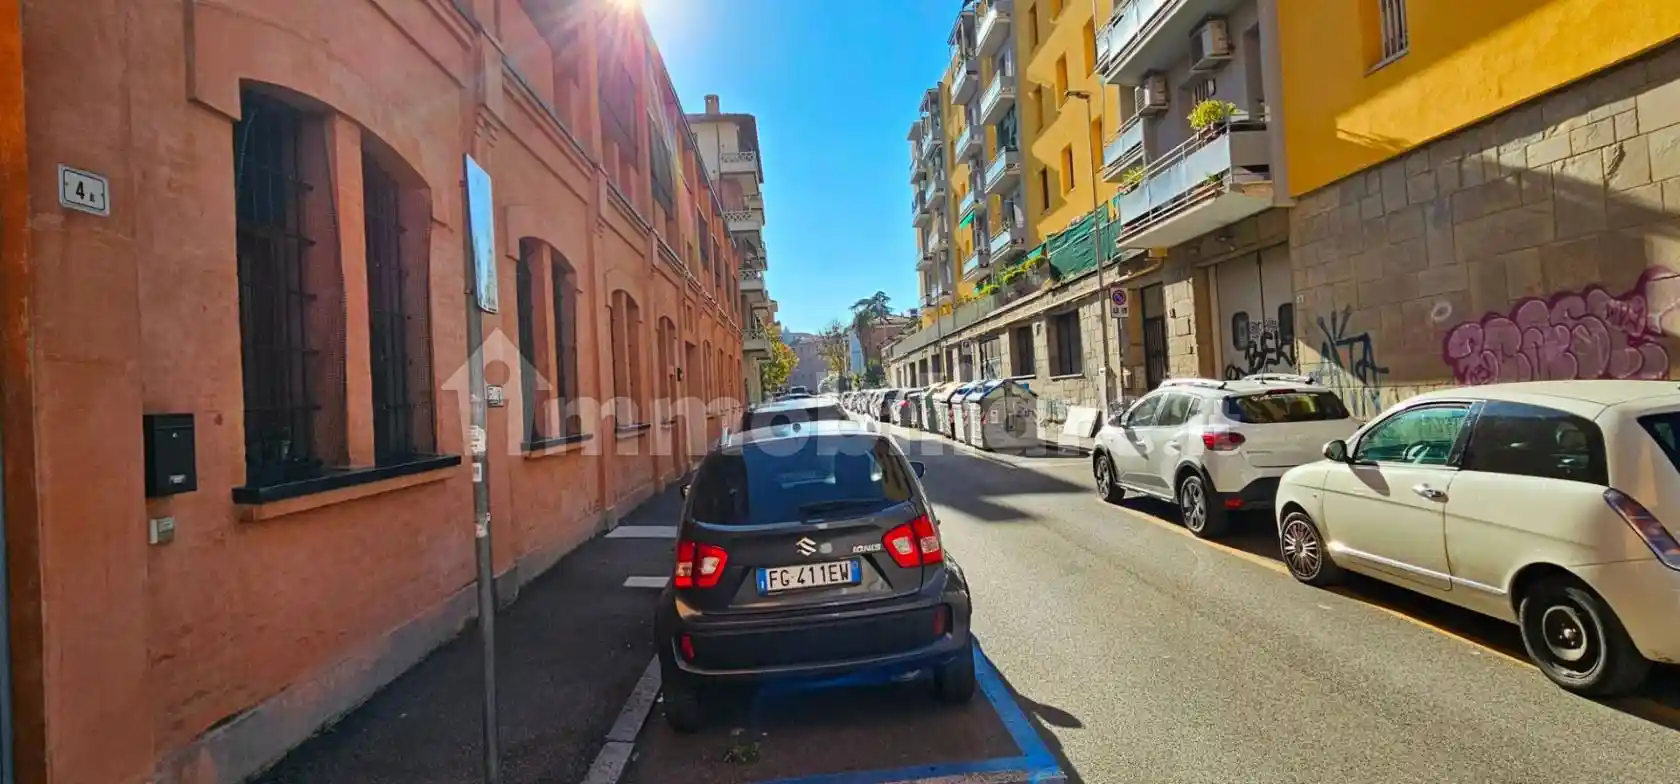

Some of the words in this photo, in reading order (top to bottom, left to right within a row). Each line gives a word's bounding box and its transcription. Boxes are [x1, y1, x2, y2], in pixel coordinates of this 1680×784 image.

[76, 181, 85, 200] 4
[769, 569, 789, 588] FG
[797, 563, 848, 584] 411EW
